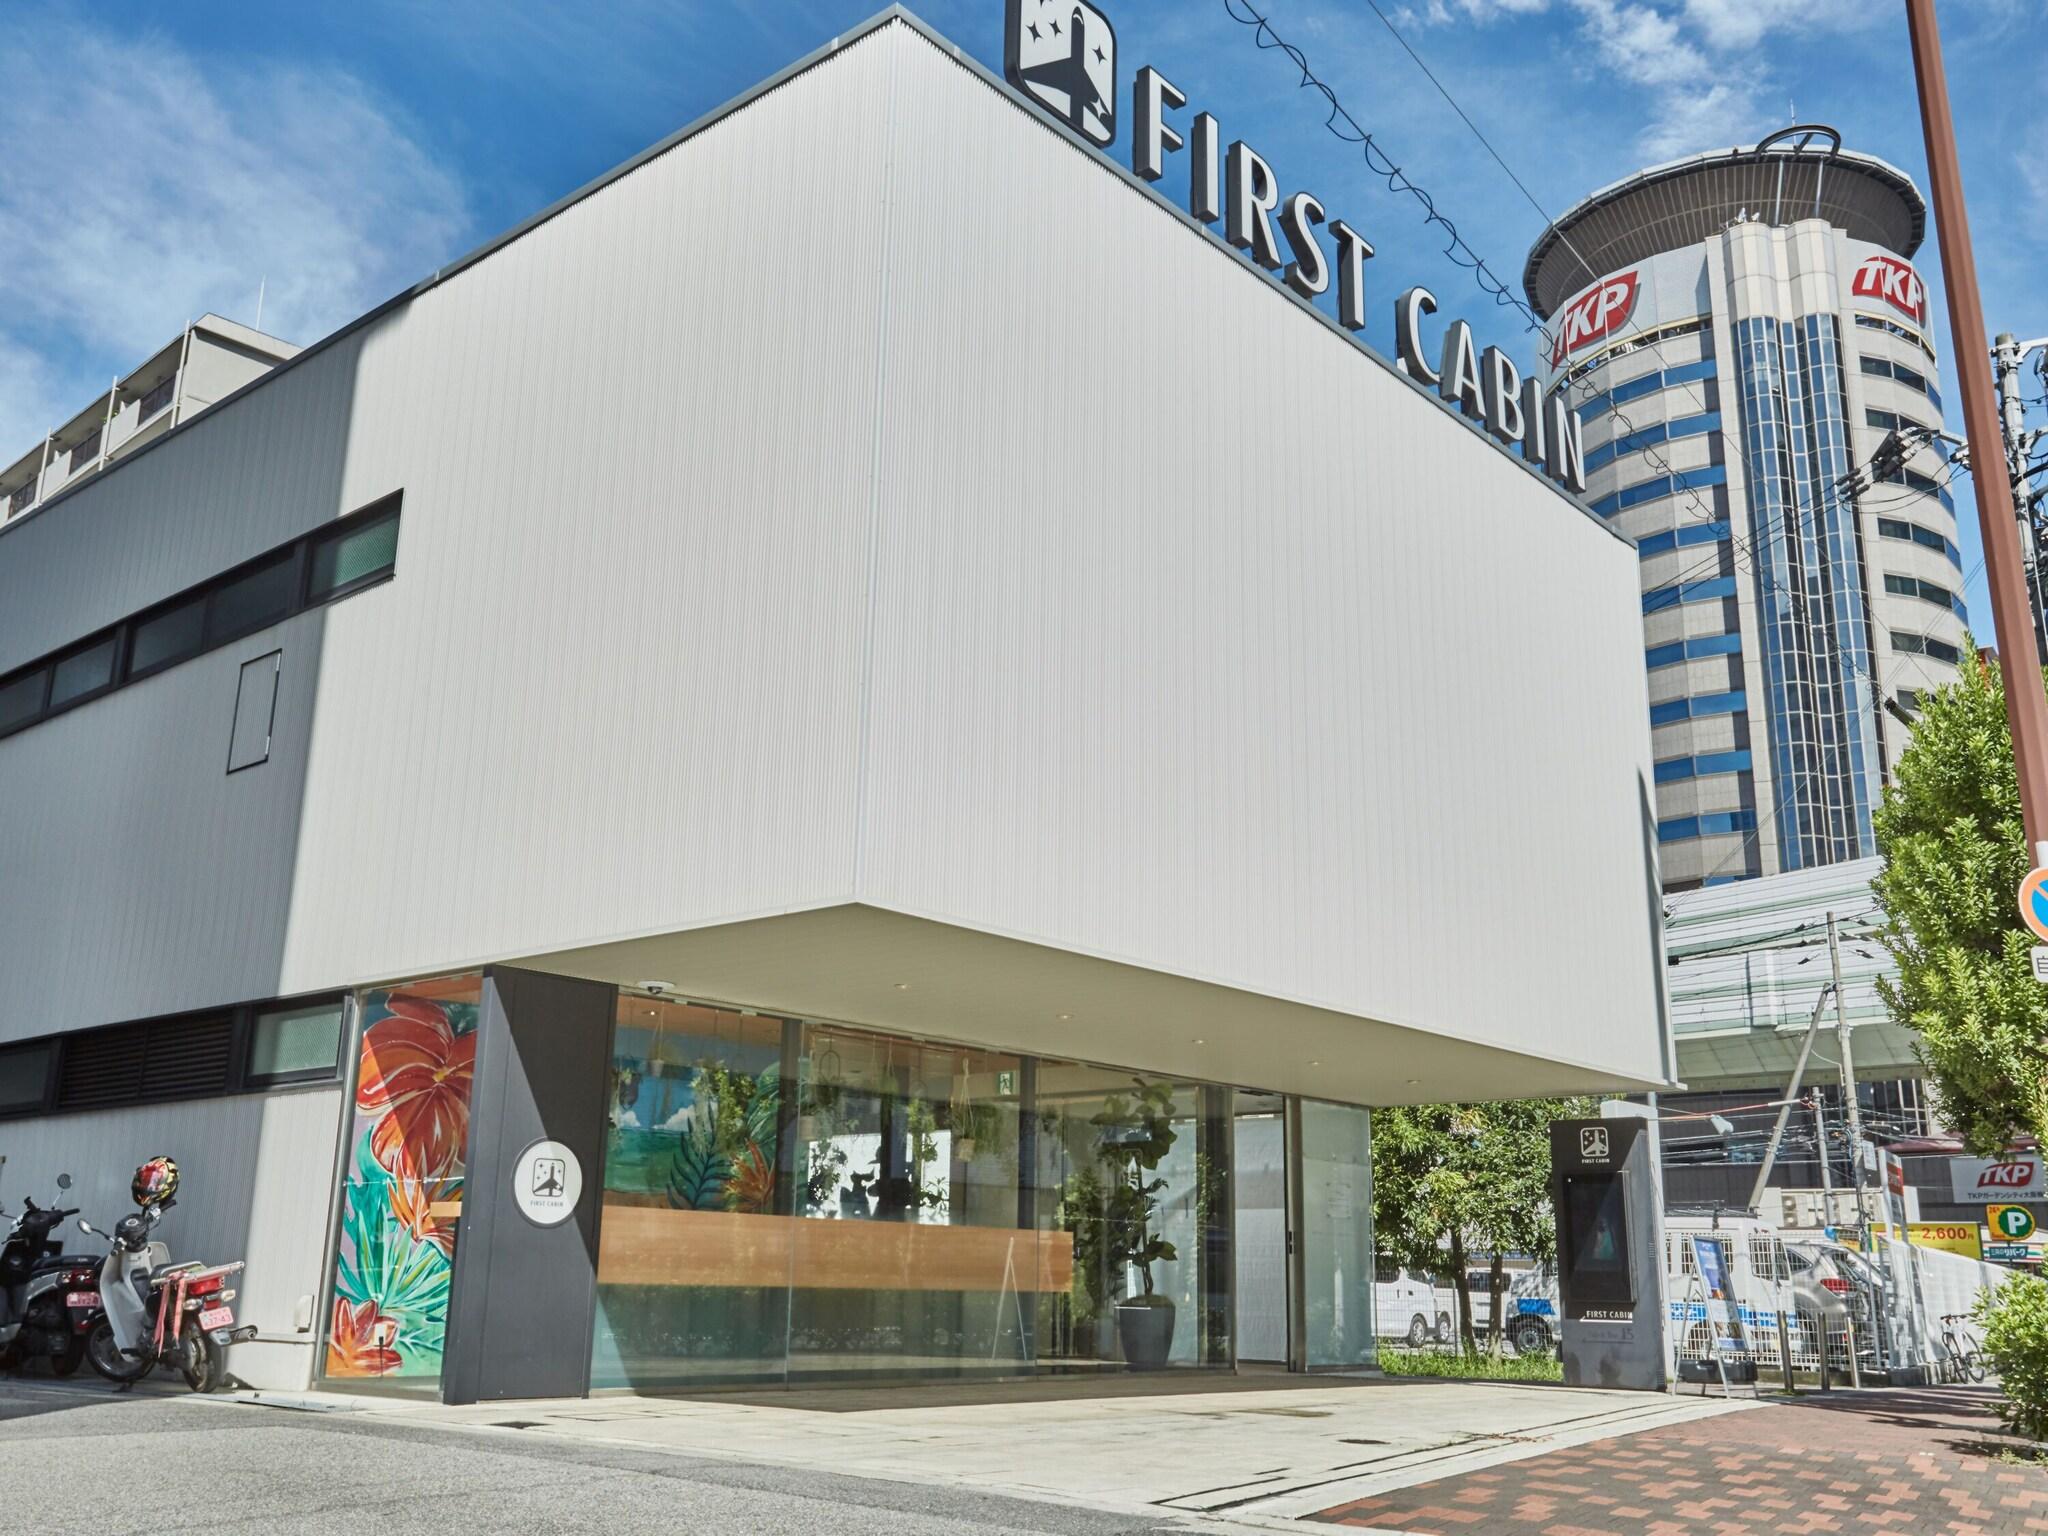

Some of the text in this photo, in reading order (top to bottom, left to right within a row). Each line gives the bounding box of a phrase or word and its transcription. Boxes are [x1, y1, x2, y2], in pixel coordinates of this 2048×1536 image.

[1133, 65, 1585, 494] FIRST CABIN
[1859, 261, 1922, 309] TKP
[1557, 282, 1629, 358] TKP
[1981, 1164, 2030, 1183] TKP
[547, 1200, 564, 1208] CABIN
[2007, 1211, 2027, 1234] P
[1586, 1310, 1633, 1320] FIRST CABIN
